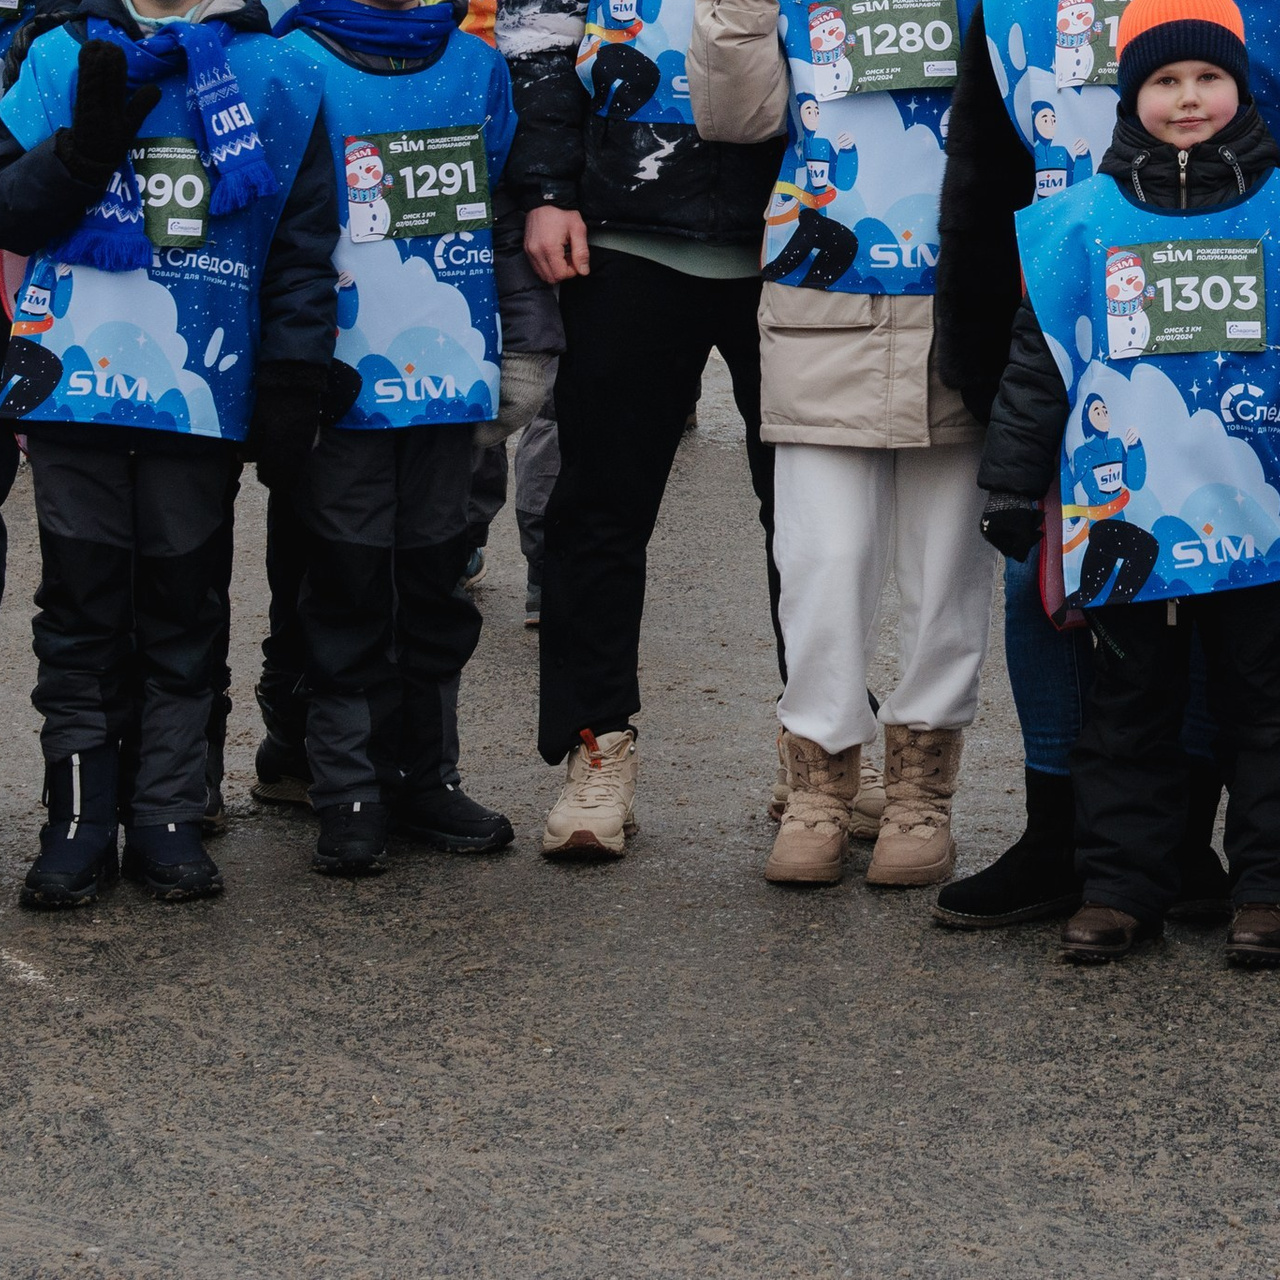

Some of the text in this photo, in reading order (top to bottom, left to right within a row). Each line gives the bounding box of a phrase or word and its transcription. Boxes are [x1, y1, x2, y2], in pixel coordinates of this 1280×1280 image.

[893, 2, 941, 10] ПОЛУМАРАФОН
[856, 20, 953, 56] 1280
[865, 68, 885, 76] ОМСК
[858, 75, 894, 83] 07/01/2024
[427, 134, 479, 144] РОЖДЕСТВЕНСКИЙ
[427, 141, 471, 150] ПОЛУМАРАФОН
[399, 160, 476, 199] 1291
[427, 211, 436, 219] КМ
[1196, 247, 1258, 255] РОЖДЕСТВЕНСКИЙ
[151, 269, 181, 279] ТОВАРЫ
[184, 272, 200, 281] ДЛЯ
[1156, 275, 1258, 312] 1303
[1155, 334, 1193, 342] 07/01/2024
